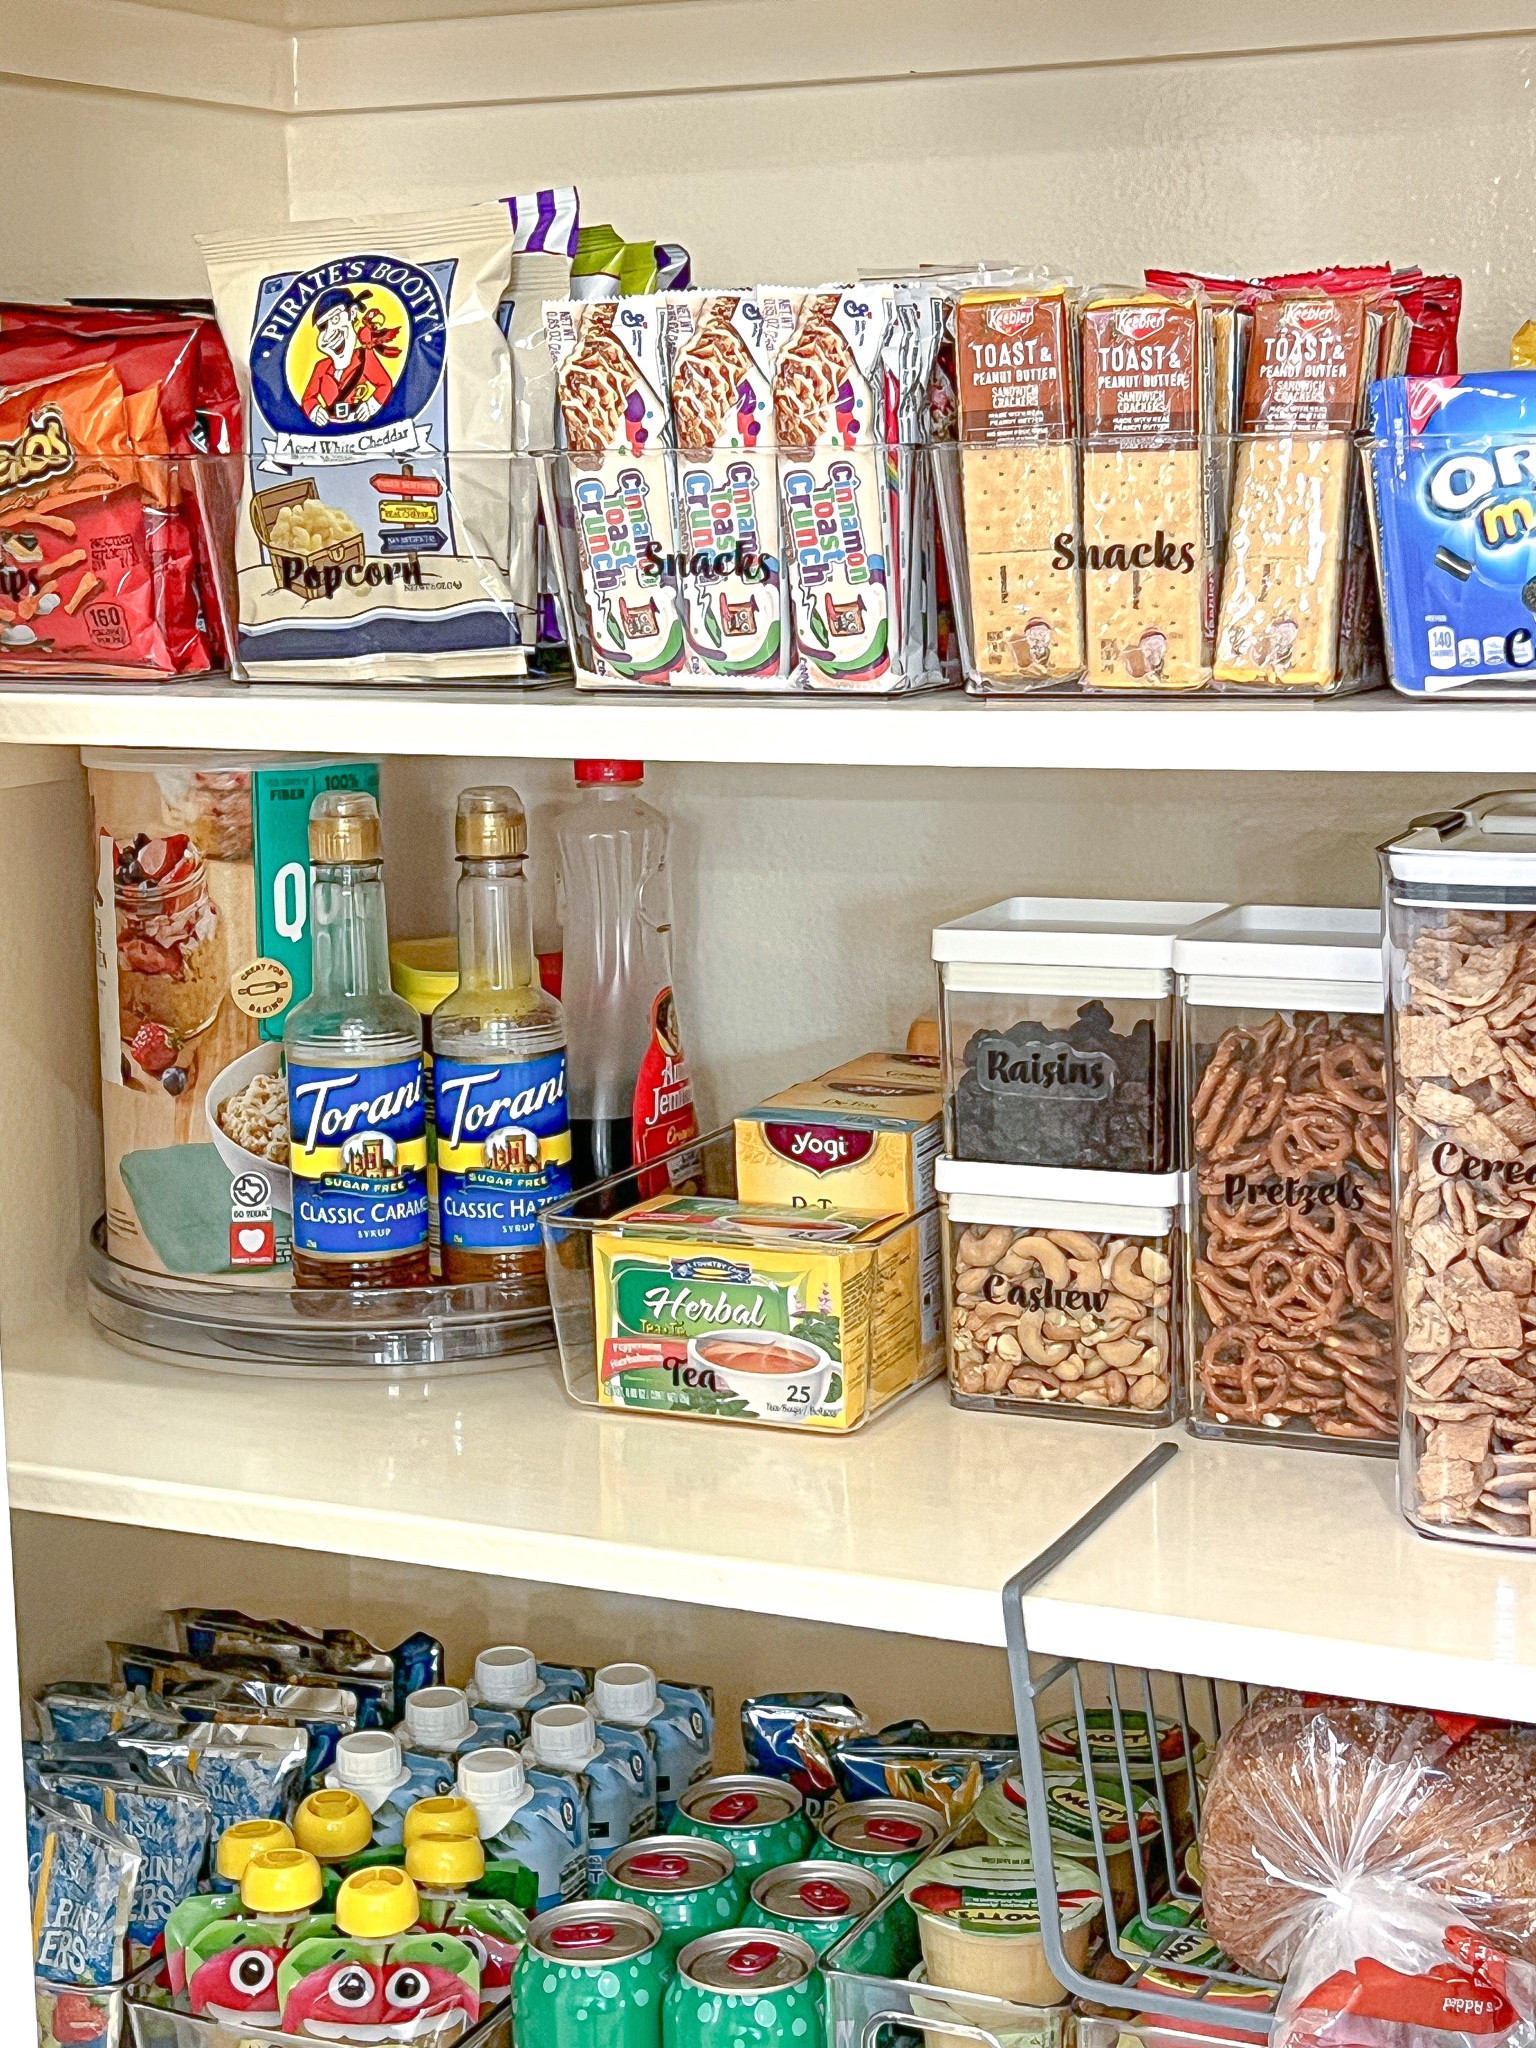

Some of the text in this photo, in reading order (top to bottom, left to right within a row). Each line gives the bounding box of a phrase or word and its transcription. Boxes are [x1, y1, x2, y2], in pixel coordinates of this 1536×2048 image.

[262, 261, 440, 342] PIRATE'S BOOTY
[1287, 302, 1333, 321] Keebler
[988, 308, 1032, 329] Keebler
[1116, 310, 1164, 331] Keebler
[972, 340, 1053, 369] TOAST &
[1099, 346, 1181, 372] TOAST &
[1264, 336, 1332, 362] TOAST
[973, 367, 1057, 386] PEANUT BUTTER
[1097, 373, 1185, 390] PEANUT BUTTER
[1260, 363, 1348, 379] PEANUT BUTTER
[358, 428, 409, 451] Cheddar
[1431, 445, 1536, 511] OR
[579, 483, 622, 589] Crunch
[604, 495, 637, 569] Toast
[787, 475, 830, 584] Crunch
[813, 487, 846, 564] Toast
[832, 466, 869, 582] Cinnamon
[644, 540, 771, 583] Snacks
[1052, 530, 1196, 574] Snacks
[281, 556, 423, 599] Popcorn
[90, 606, 122, 627] 160
[1433, 631, 1452, 648] 140
[325, 773, 359, 790] 100%
[987, 1050, 1104, 1088] Raisins
[295, 1062, 422, 1155] Torani
[442, 1058, 565, 1151] Torani
[324, 1177, 405, 1193] SUGAR FREE
[468, 1172, 548, 1188] SUGAR FREE
[1224, 1173, 1365, 1215] Pretzels
[300, 1196, 428, 1225] CLASSIC CARAME
[444, 1197, 505, 1219] CLASSIC
[358, 1227, 392, 1239] SYRUP
[502, 1223, 535, 1234] SYRUP
[643, 1286, 768, 1328] Herbal
[982, 1275, 1110, 1313] Cashew
[662, 1356, 717, 1393] Tea
[786, 1385, 811, 1404] 25
[1442, 1997, 1484, 2015] Added
